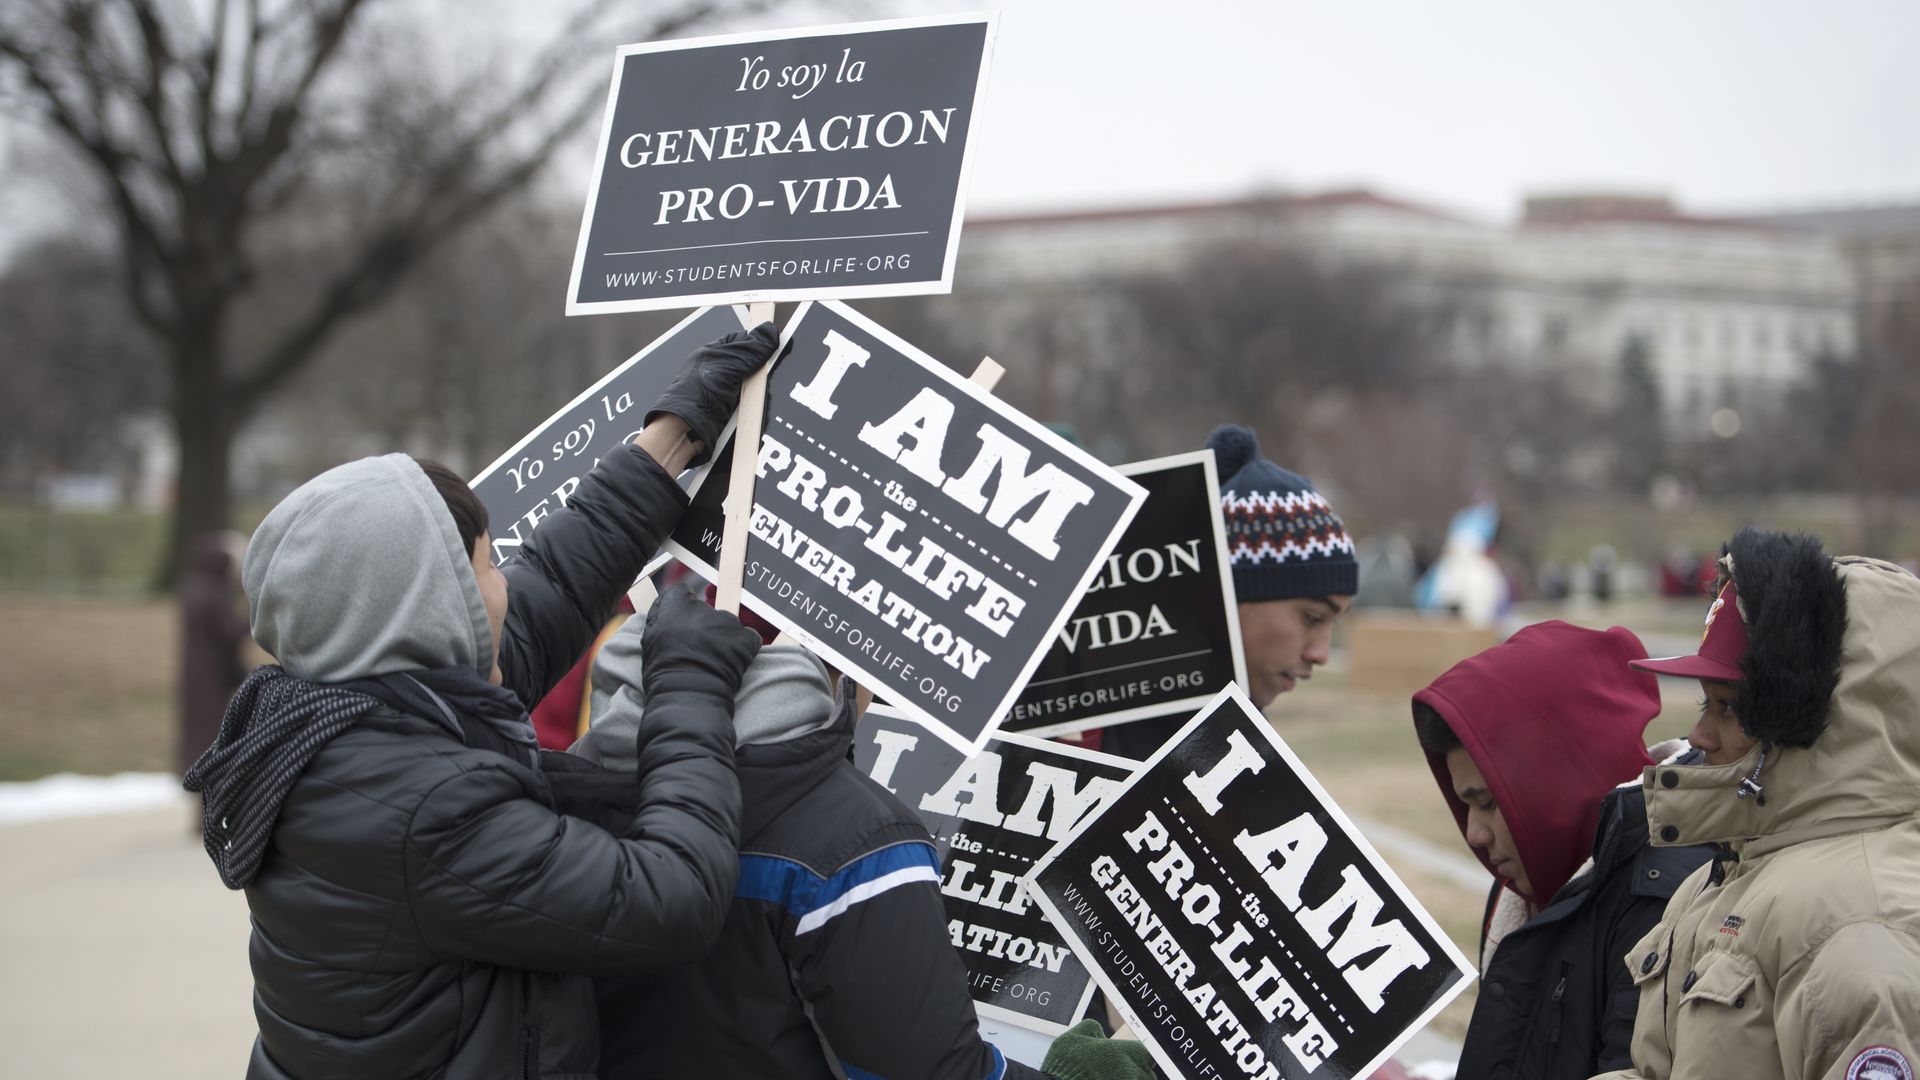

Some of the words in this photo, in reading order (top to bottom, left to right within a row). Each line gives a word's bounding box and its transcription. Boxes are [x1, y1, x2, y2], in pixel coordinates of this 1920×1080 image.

[735, 56, 770, 92] Yo
[776, 61, 827, 100] soy
[835, 48, 867, 84] la
[619, 107, 957, 168] GENERACION
[653, 173, 902, 226] PRO-VIDA
[506, 457, 545, 494] Yo
[552, 418, 596, 462] soy
[601, 392, 635, 422] la
[789, 328, 871, 420] I
[857, 387, 1095, 561] AM
[754, 433, 1027, 638] PRO-LIFE
[882, 478, 918, 514] the
[722, 502, 992, 680] ENERATION
[869, 729, 918, 794] I
[919, 751, 1125, 841] AM
[950, 831, 983, 855] the
[1182, 729, 1266, 816] I
[1233, 812, 1431, 1014] AM
[941, 859, 1050, 922] LIF
[1241, 891, 1269, 927] the
[1123, 810, 1339, 1073] PRO-LIFE
